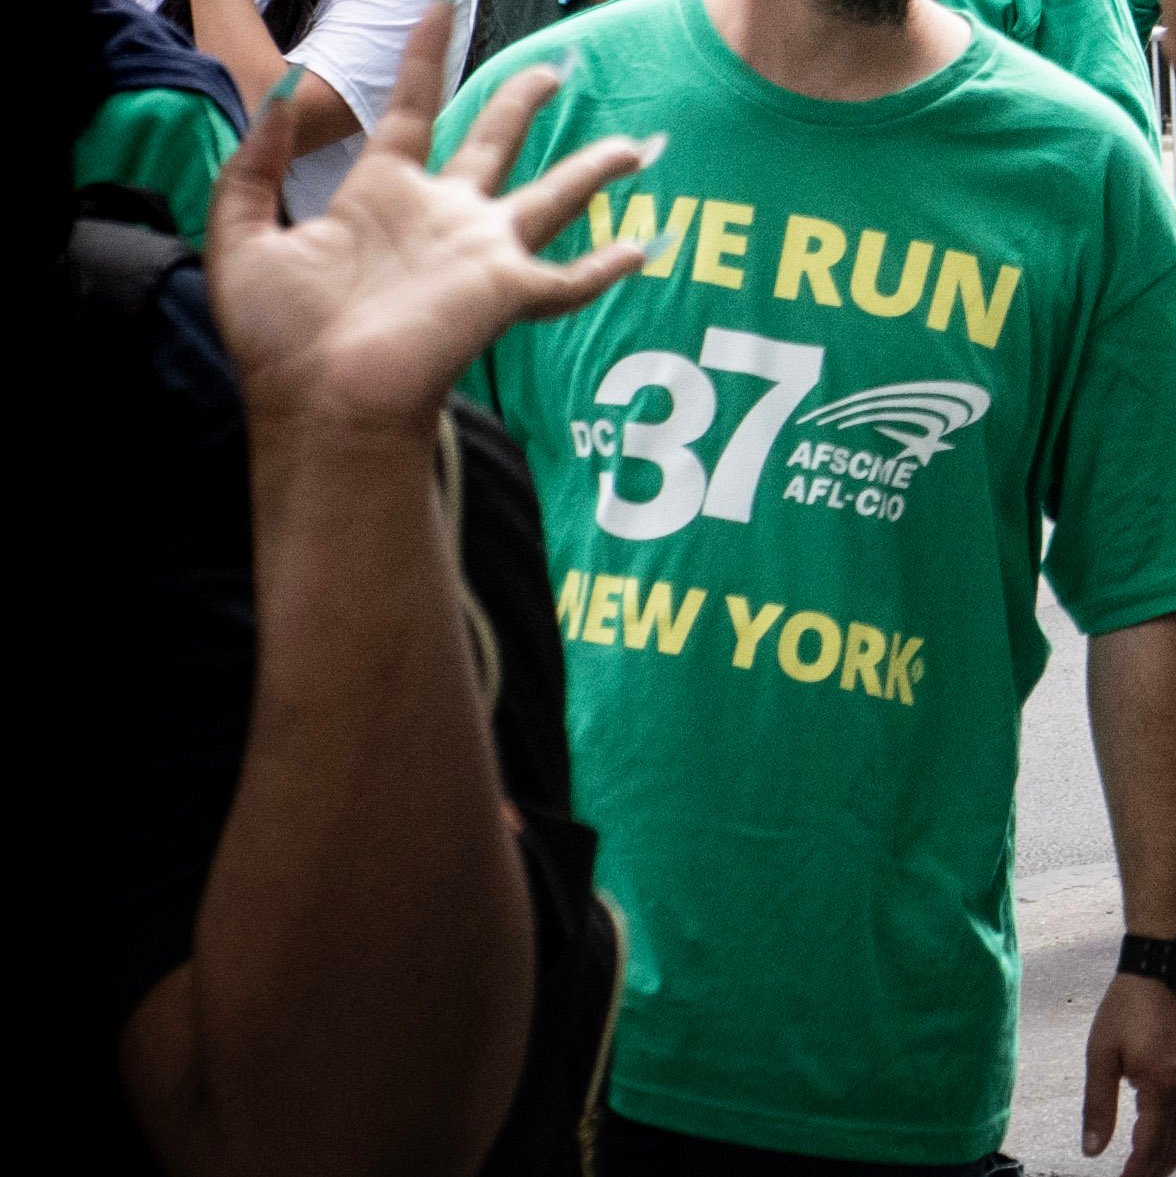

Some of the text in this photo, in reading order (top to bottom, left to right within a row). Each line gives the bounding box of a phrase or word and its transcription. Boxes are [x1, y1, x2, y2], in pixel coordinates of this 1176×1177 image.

[587, 192, 1022, 350] WE RUN
[570, 326, 825, 541] DC 37
[786, 440, 919, 489] AFSCME
[783, 474, 905, 522] AFL-CIO
[555, 568, 707, 656] NEW
